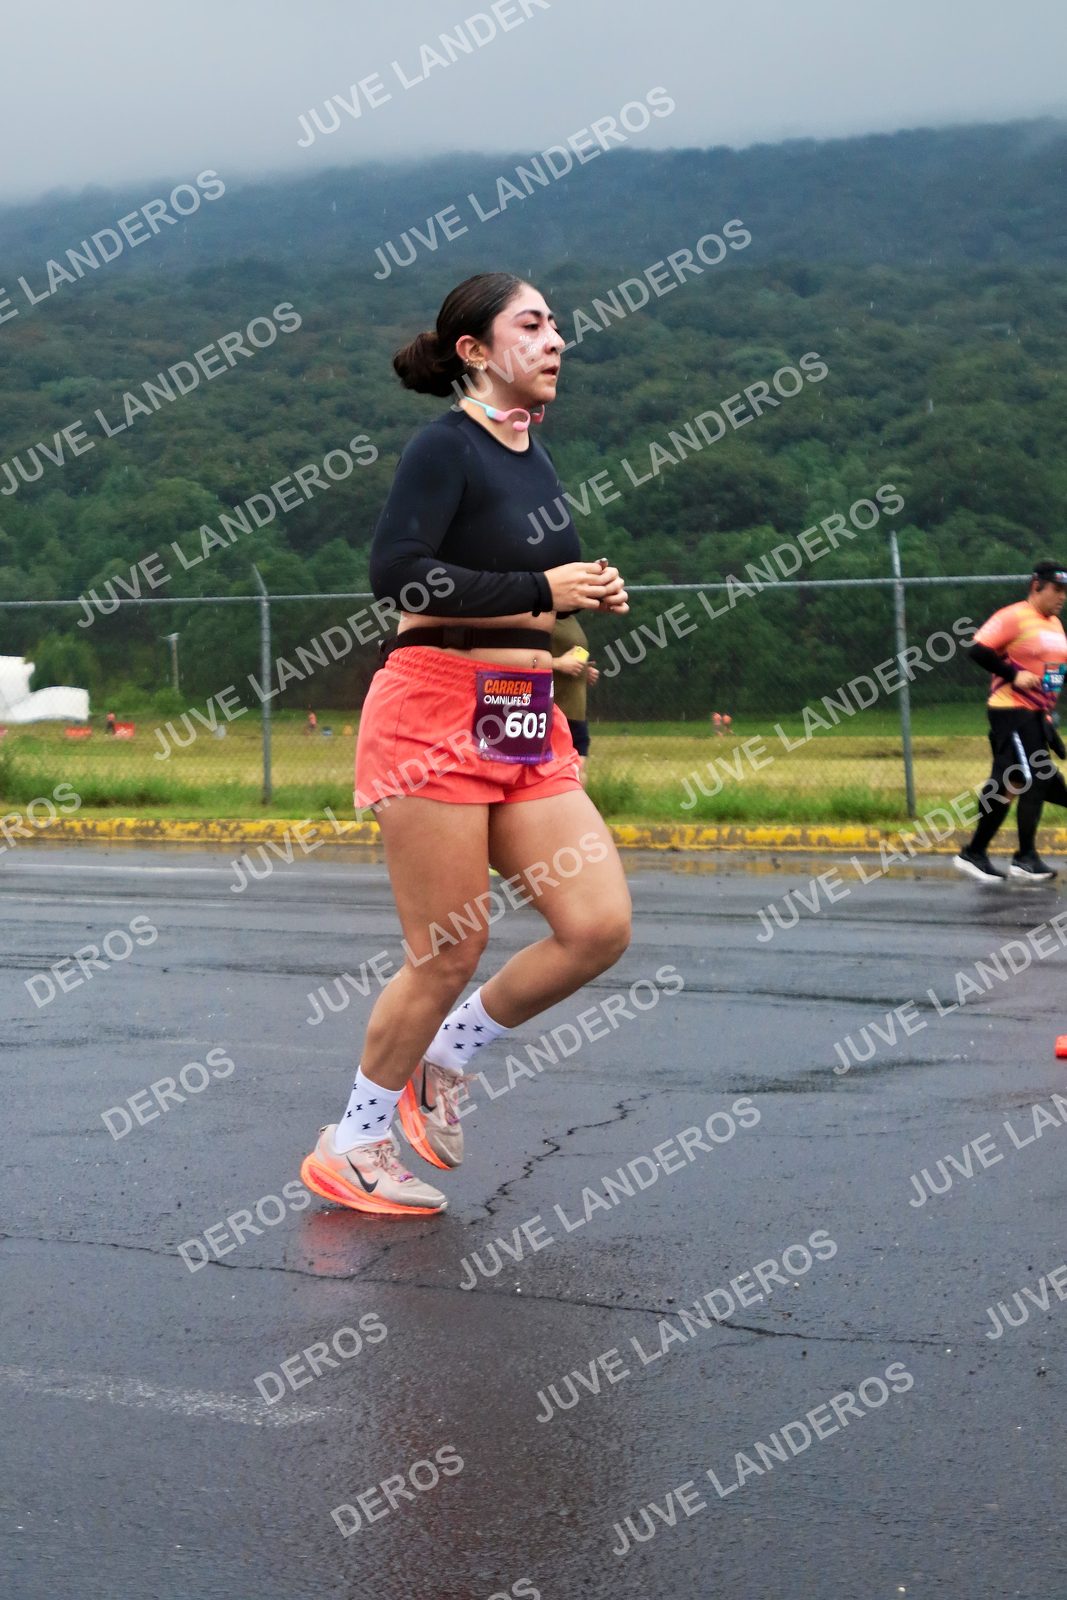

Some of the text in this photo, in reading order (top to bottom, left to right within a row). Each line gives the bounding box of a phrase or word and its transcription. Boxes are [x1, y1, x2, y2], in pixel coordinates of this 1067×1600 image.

[484, 680, 532, 694] CARRERA
[484, 694, 522, 706] OMNILIFE
[505, 712, 547, 739] 603
